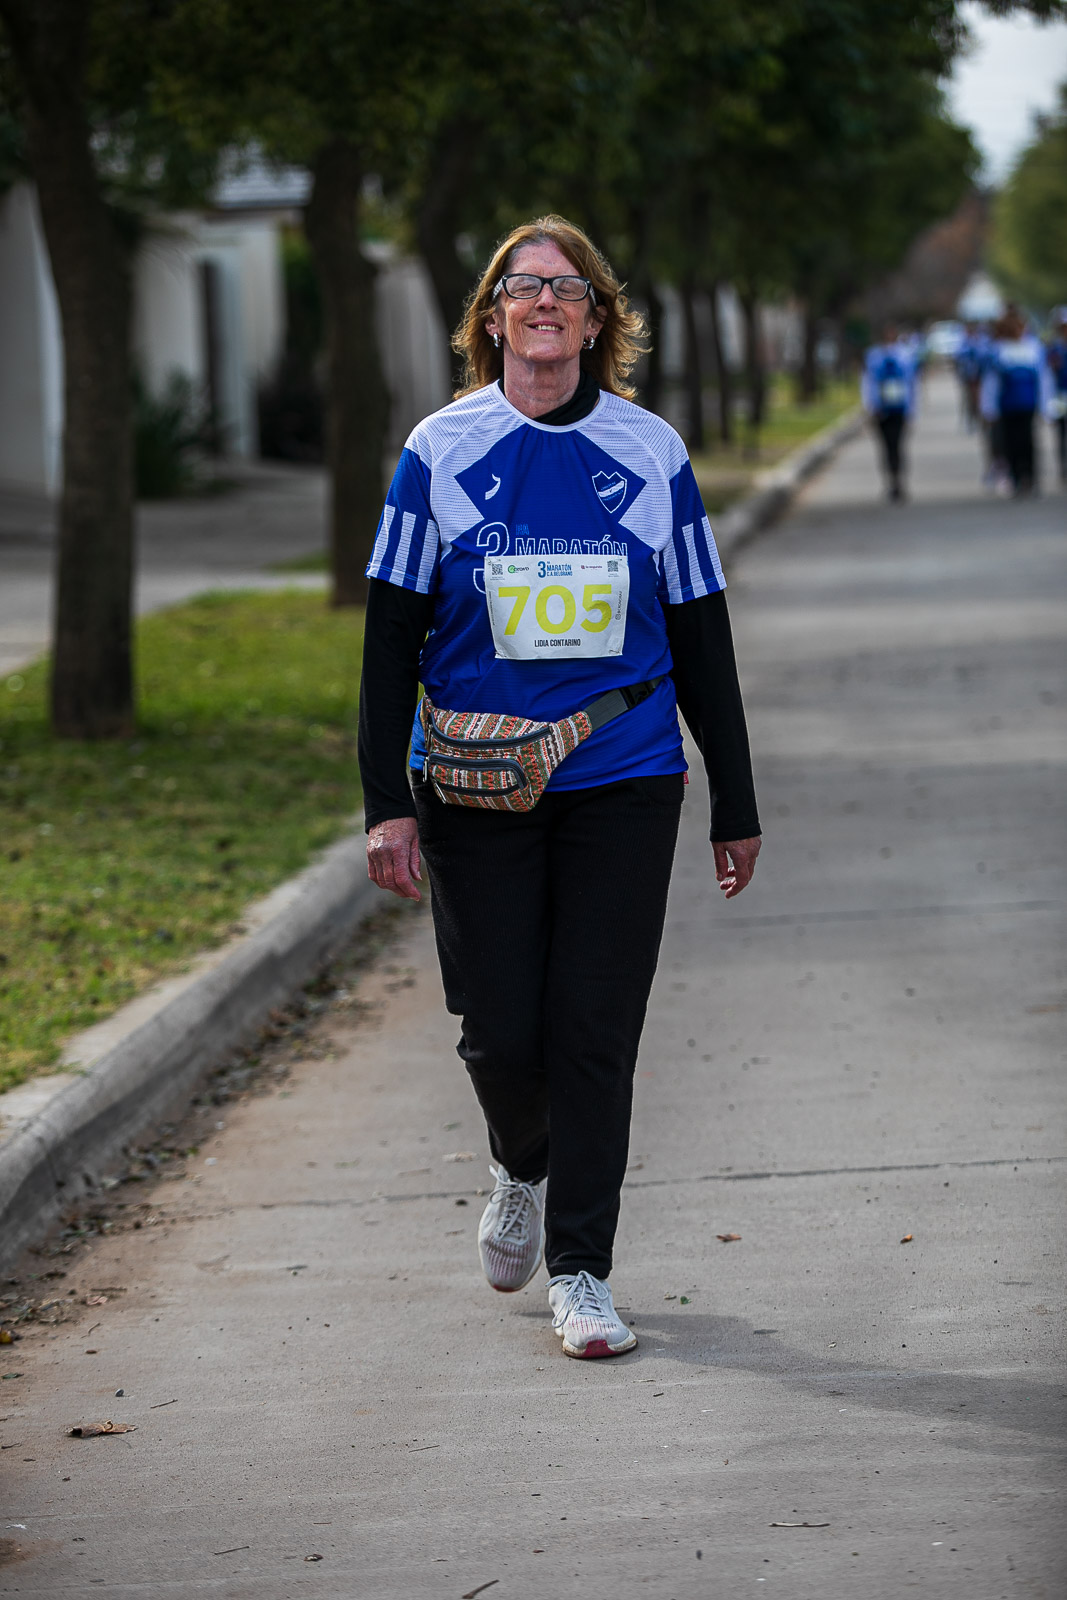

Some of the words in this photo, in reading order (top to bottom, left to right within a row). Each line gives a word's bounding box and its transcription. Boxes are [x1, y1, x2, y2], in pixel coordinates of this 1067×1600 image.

[515, 534, 628, 557] MARATÓN
[538, 561, 546, 578] 3
[498, 584, 612, 636] 705
[534, 640, 549, 648] LIDIA
[550, 638, 581, 648] CONTARINO
